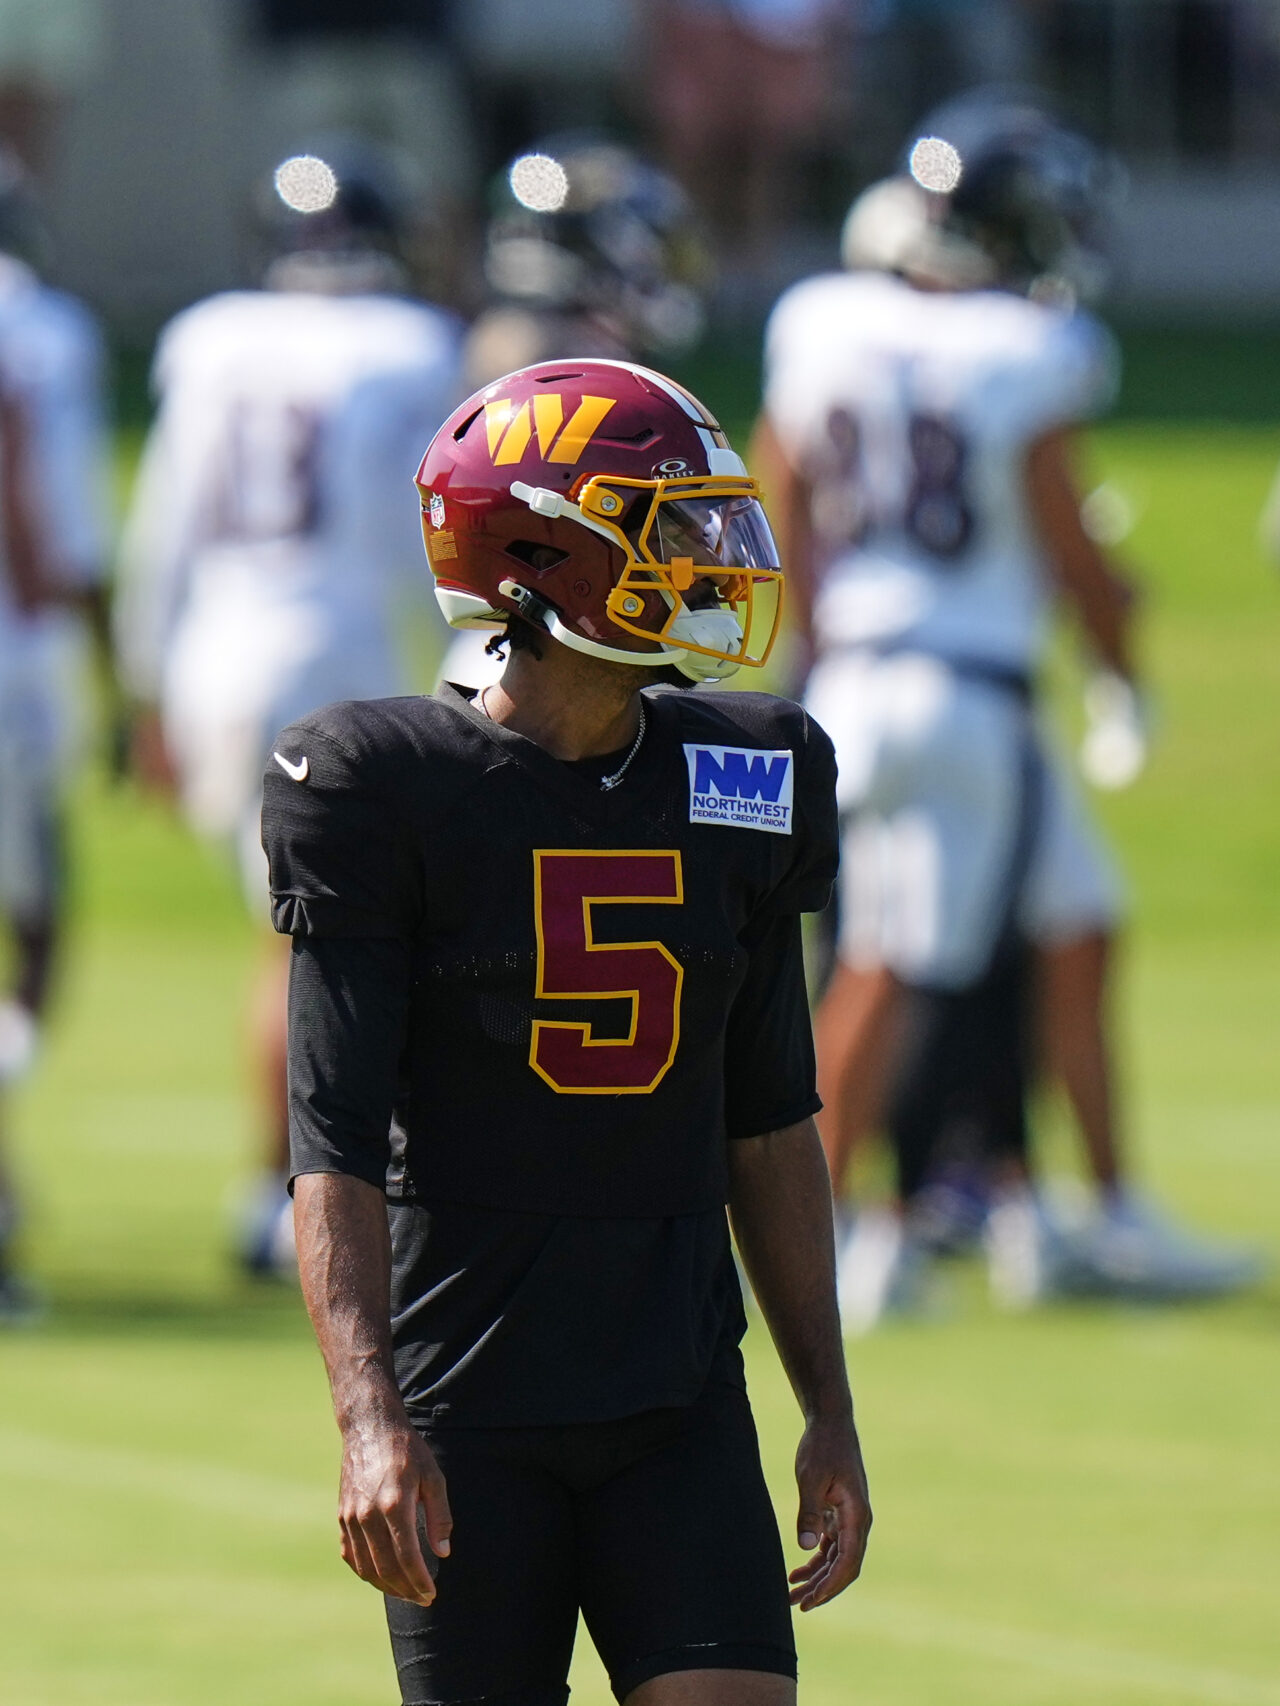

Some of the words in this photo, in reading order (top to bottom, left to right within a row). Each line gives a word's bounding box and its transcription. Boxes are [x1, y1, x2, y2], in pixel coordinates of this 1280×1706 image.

[484, 394, 617, 466] W
[654, 470, 694, 480] OAKLEY
[694, 750, 789, 802] NW
[693, 795, 789, 818] NORTHWEST
[693, 809, 728, 819] FEDERAL
[731, 814, 759, 823] CREDIT
[761, 818, 785, 827] UNION
[529, 848, 684, 1094] 5
